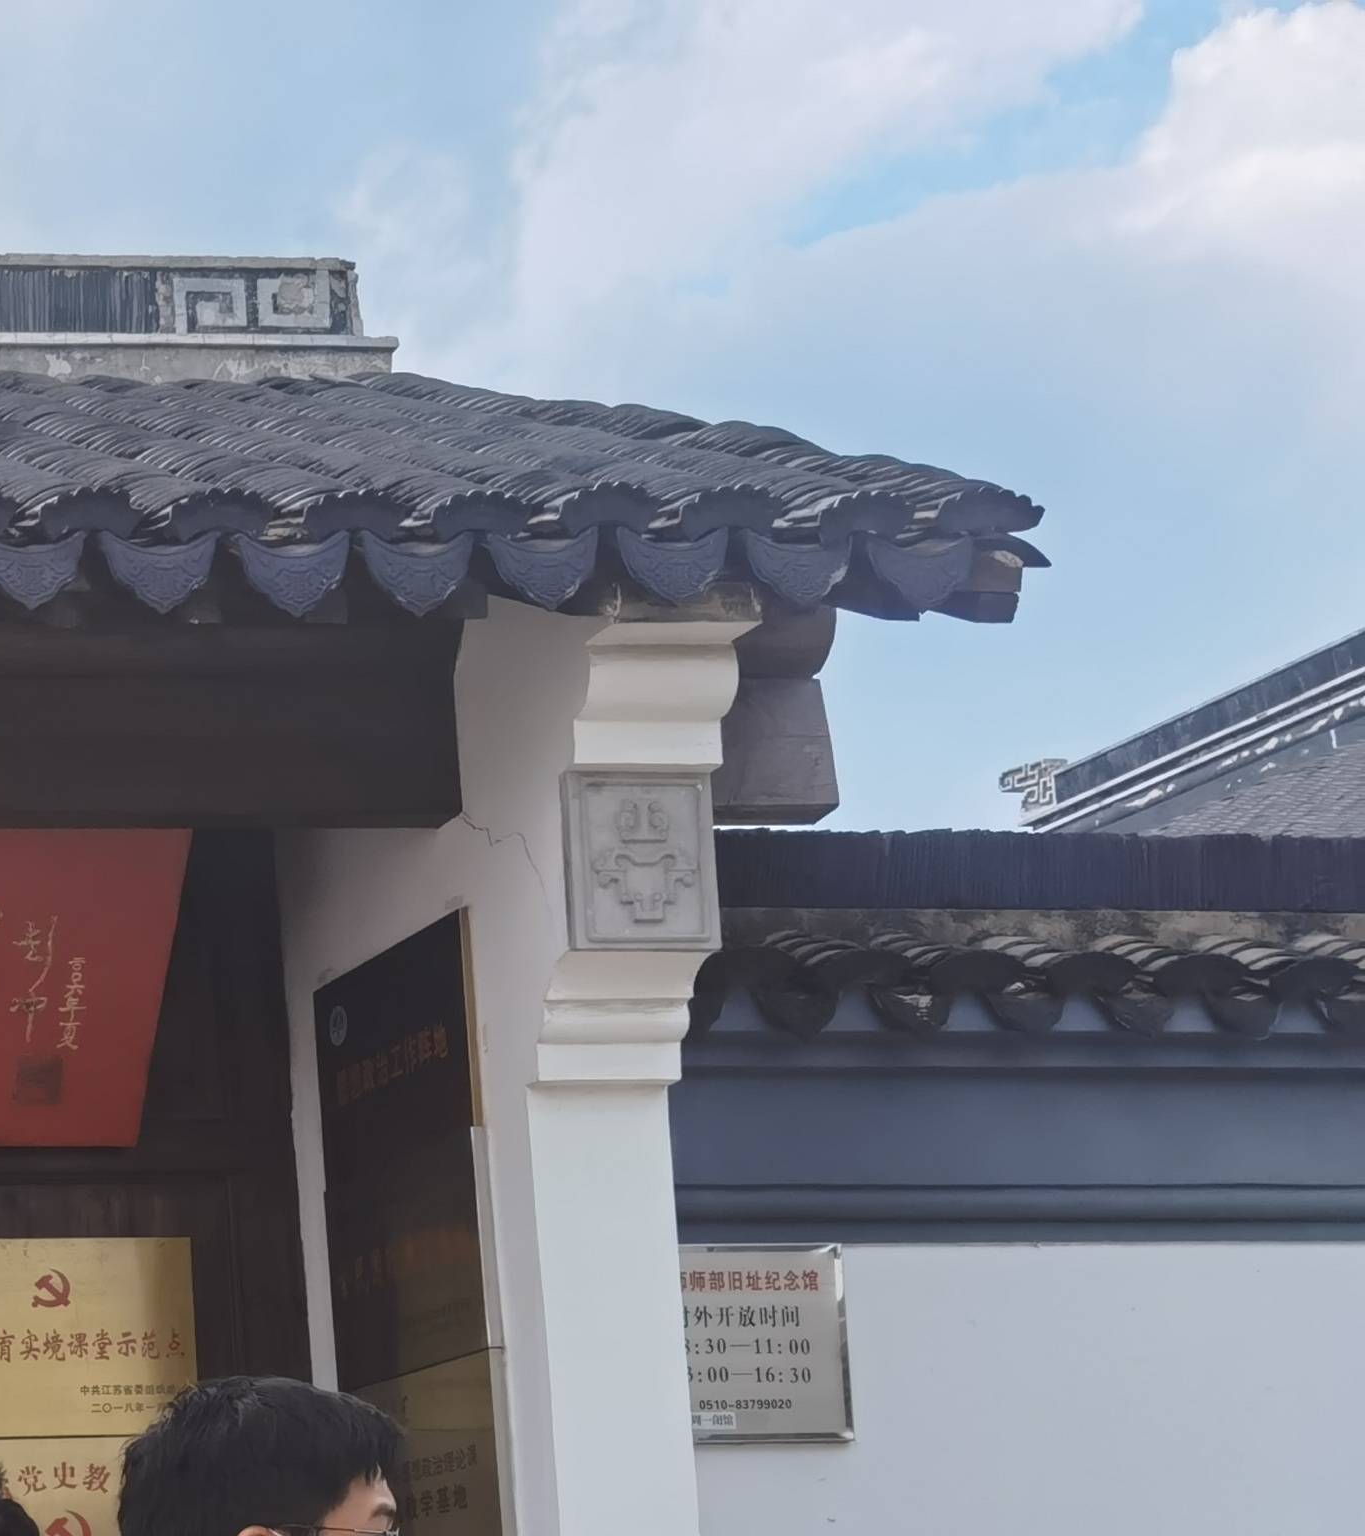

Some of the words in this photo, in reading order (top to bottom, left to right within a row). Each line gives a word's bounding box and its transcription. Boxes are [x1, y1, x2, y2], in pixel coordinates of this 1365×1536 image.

[699, 1399, 792, 1410] 0510-83799020
[3, 1461, 111, 1498] 党史教
